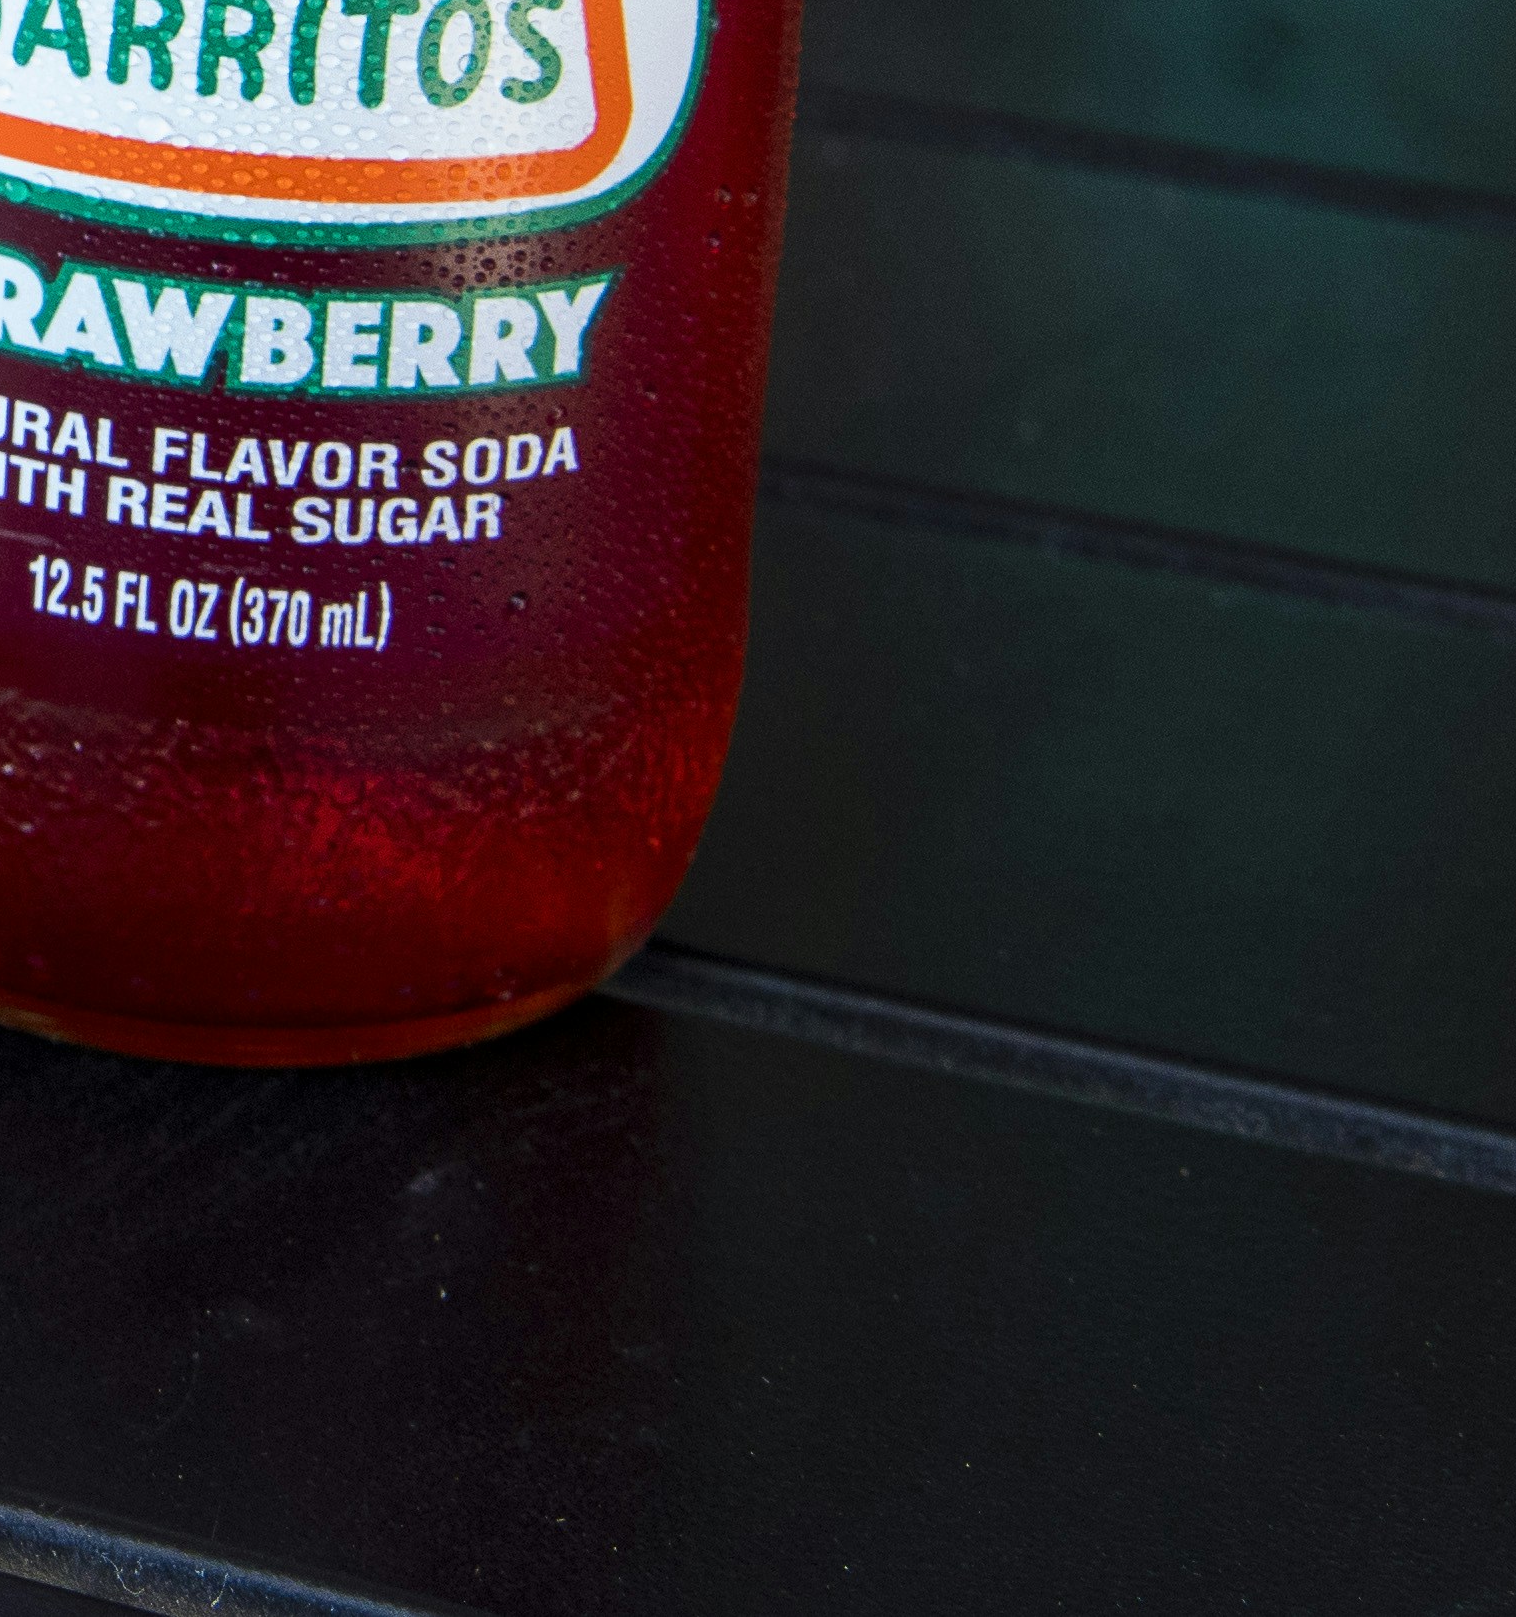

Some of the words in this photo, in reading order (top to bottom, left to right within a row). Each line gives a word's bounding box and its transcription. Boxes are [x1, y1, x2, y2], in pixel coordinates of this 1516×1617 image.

[151, 426, 400, 489] FLAVOR
[420, 426, 579, 488] SODA
[106, 475, 270, 541] REAL
[290, 491, 505, 545] SUGAR
[27, 554, 104, 624] 12.5
[114, 570, 157, 632] FL
[169, 578, 220, 639] OZ
[229, 576, 311, 648] (370
[319, 581, 392, 652] mL)
